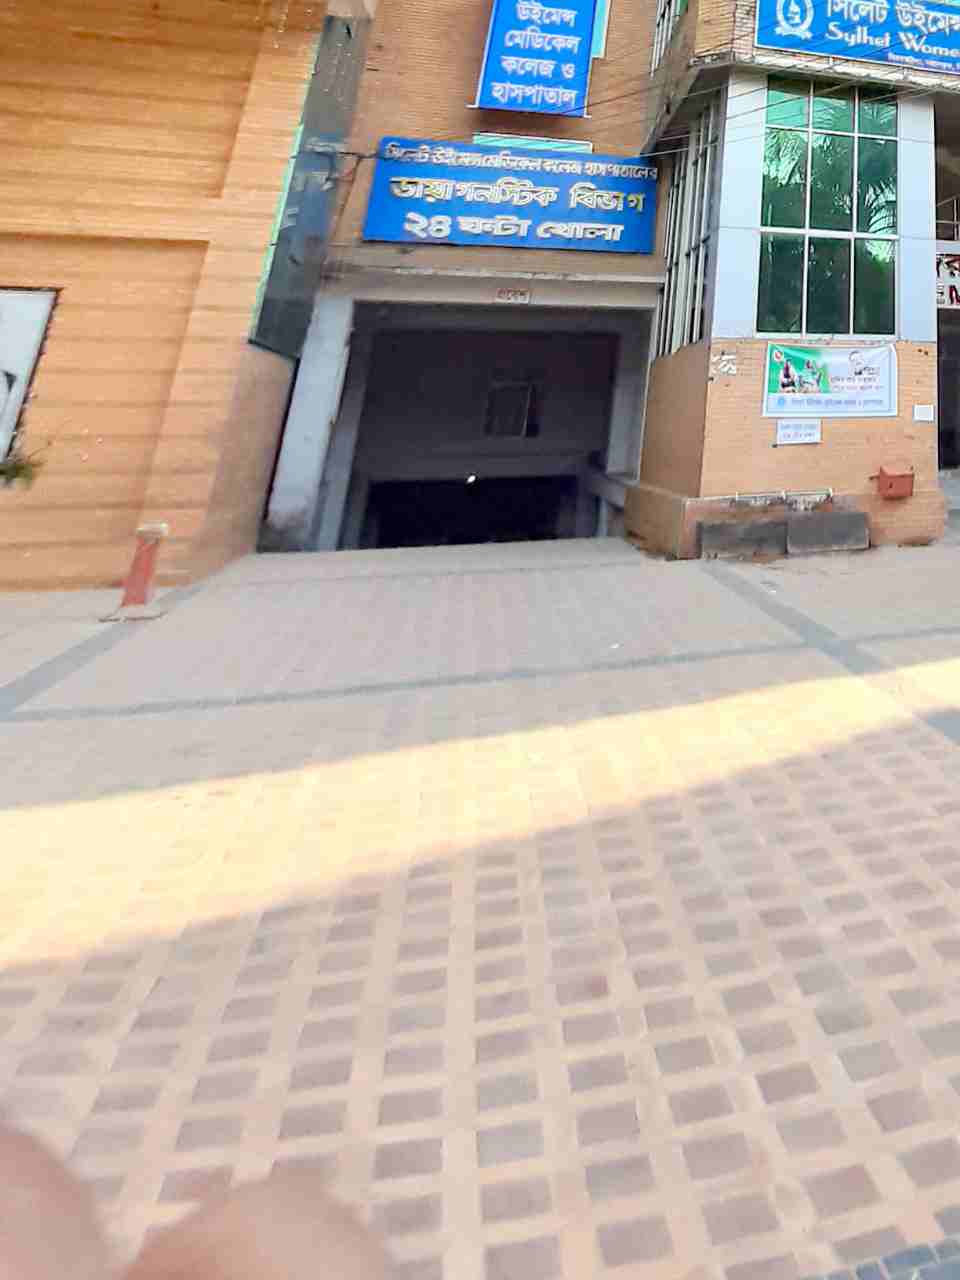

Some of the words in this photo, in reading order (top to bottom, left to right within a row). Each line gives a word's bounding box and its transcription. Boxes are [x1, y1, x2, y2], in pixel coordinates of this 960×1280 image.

[826, 21, 891, 51] Sylhet
[501, 55, 557, 79] কলেজ
[491, 80, 578, 108] হাসপাতাল
[403, 211, 452, 239] ২৪
